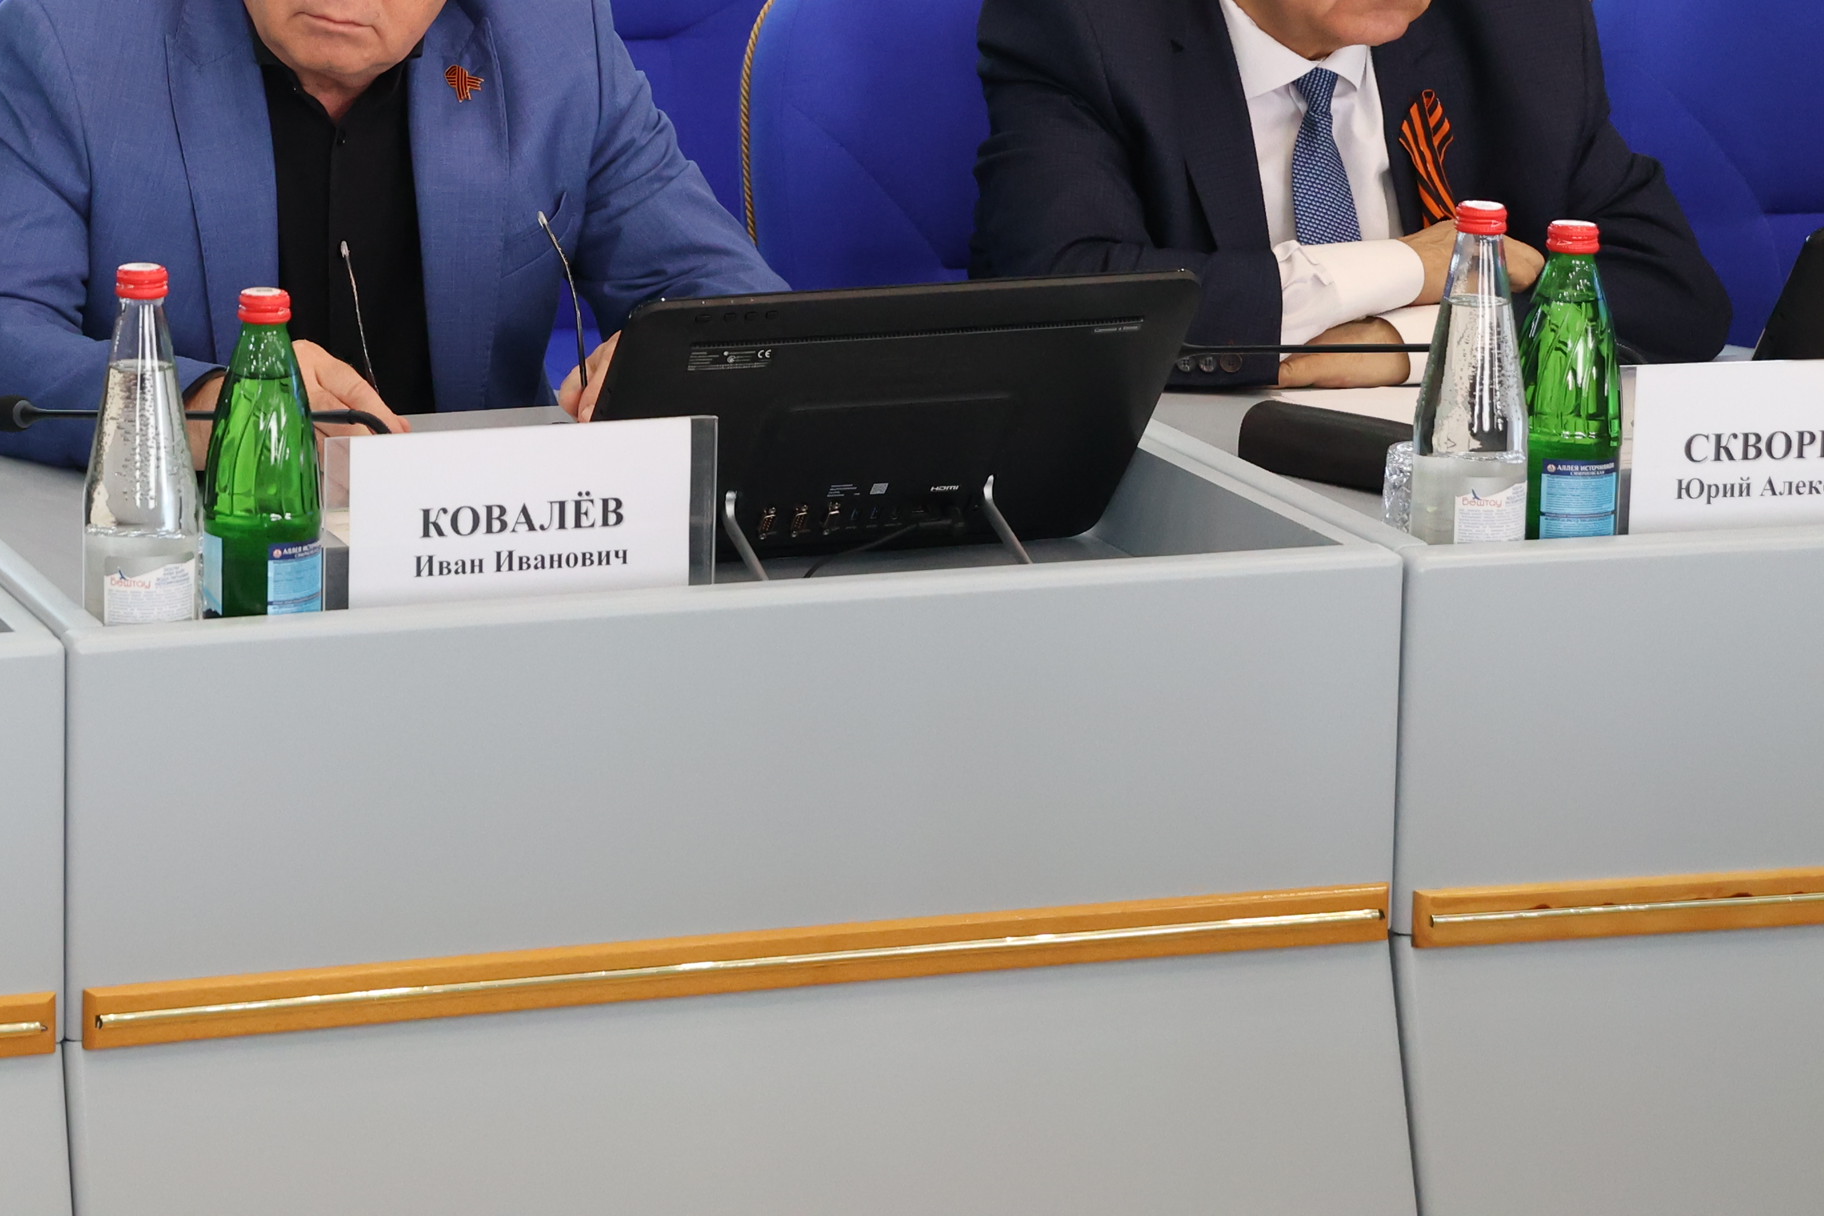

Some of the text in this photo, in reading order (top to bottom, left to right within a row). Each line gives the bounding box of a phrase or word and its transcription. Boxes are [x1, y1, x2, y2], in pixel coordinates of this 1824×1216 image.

[1675, 476, 1824, 505] Юрий Алек
[419, 491, 624, 538] КОВАЛЁВ
[414, 549, 629, 577] Иван Иванович
